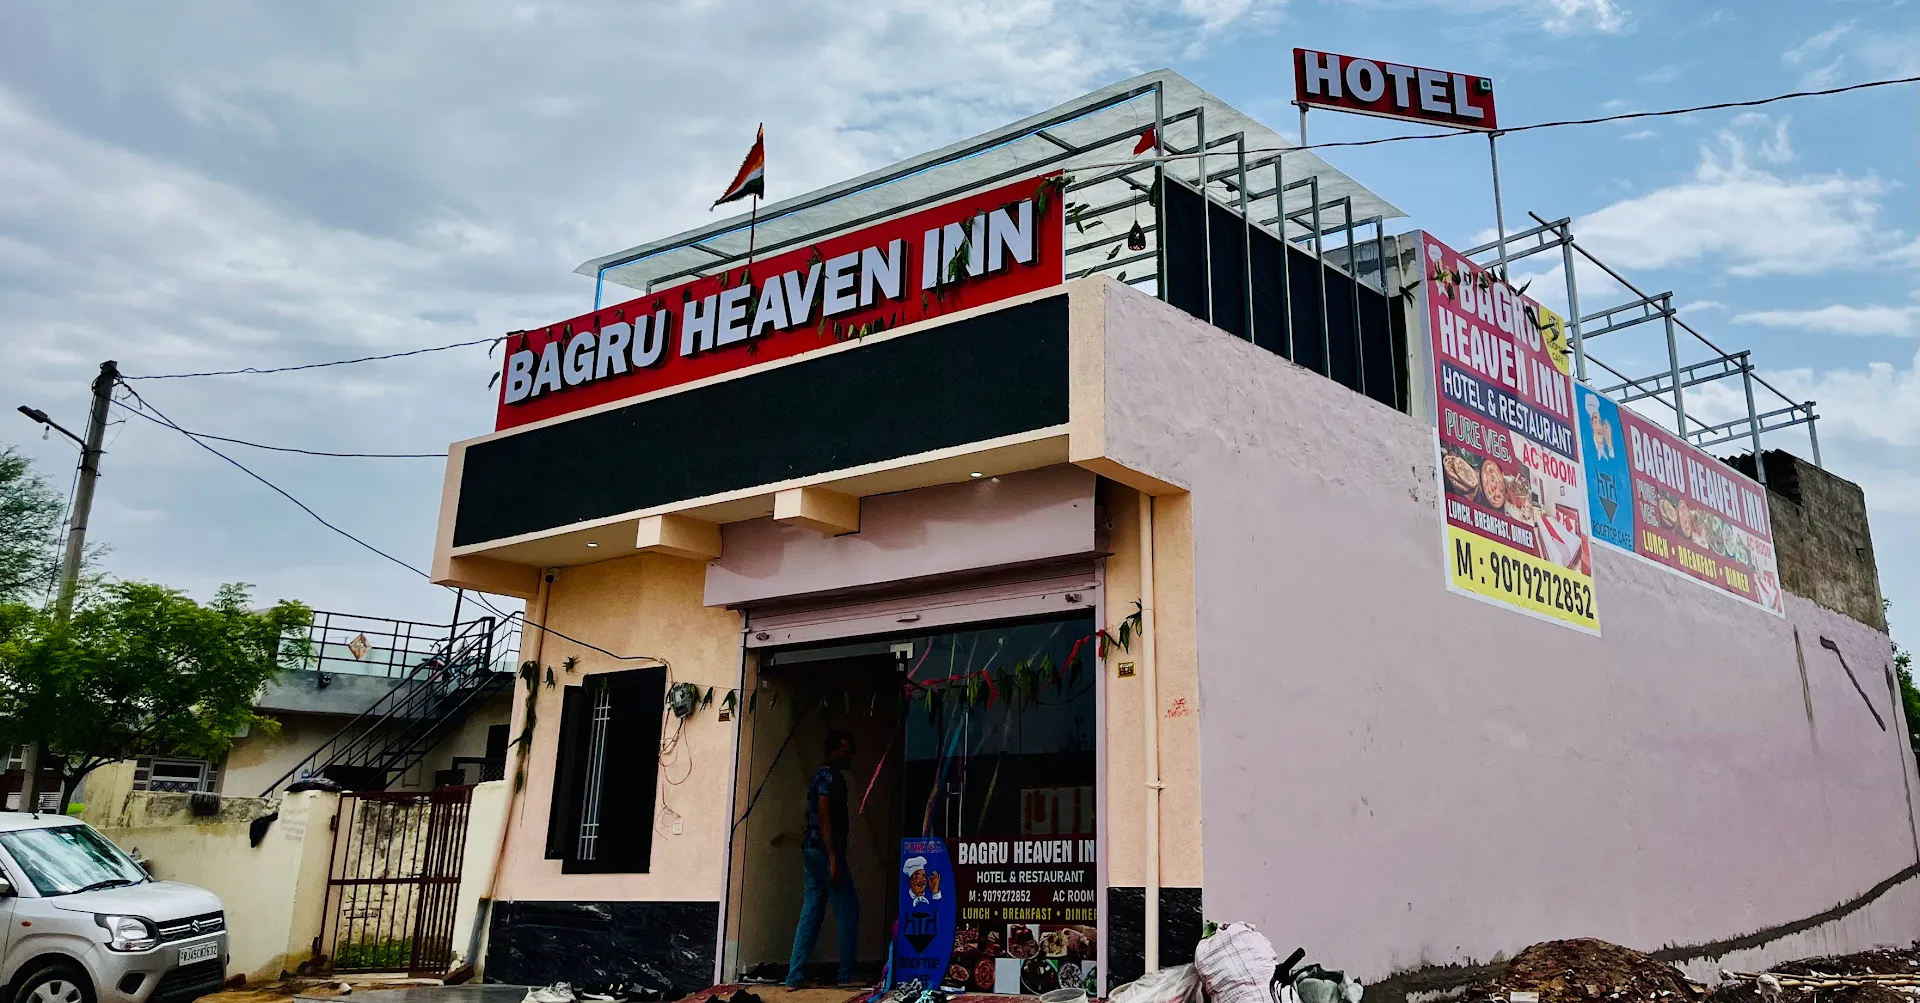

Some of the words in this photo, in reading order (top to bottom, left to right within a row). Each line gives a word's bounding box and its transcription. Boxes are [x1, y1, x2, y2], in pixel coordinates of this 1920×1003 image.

[1304, 50, 1484, 119] HOTEL
[504, 307, 671, 406] BAGRU
[680, 238, 905, 357] HEAVEN
[922, 199, 1036, 292] INN
[1456, 258, 1542, 353] BAGRU
[1437, 304, 1529, 397] HEAVEN
[1531, 357, 1569, 419] INN
[1442, 364, 1486, 412] HOTEL
[1487, 388, 1498, 419] &
[1498, 393, 1573, 455] RESTAURANT
[1444, 408, 1481, 450] PURE
[1522, 442, 1539, 471] AC
[1542, 454, 1578, 489] ROOM
[1629, 424, 1687, 495] BAGRU
[1686, 455, 1743, 524] HEAVEN
[1740, 486, 1768, 536] INN
[1635, 478, 1658, 506] PURE
[1511, 524, 1535, 549] DINNER
[1617, 530, 1632, 548] CAFE
[1455, 537, 1474, 581] M
[1479, 556, 1486, 585] :
[1489, 551, 1595, 620] 9079272852
[1641, 528, 1670, 560] LUNCH
[1677, 544, 1718, 580] BREAKFAST
[1724, 565, 1751, 594] DINNER
[958, 841, 1009, 865] BAGRU
[1013, 839, 1073, 864] HEAVEN
[968, 890, 977, 902] M
[982, 890, 1031, 903] 9079272852
[1052, 889, 1066, 903] AC
[1067, 889, 1095, 903] ROOM
[976, 870, 1008, 883] HOTEL
[1009, 870, 1017, 883] &
[1018, 869, 1085, 883] RESTAURANT
[962, 907, 990, 921] LUNCH
[1002, 907, 1052, 921] BREAKFAST
